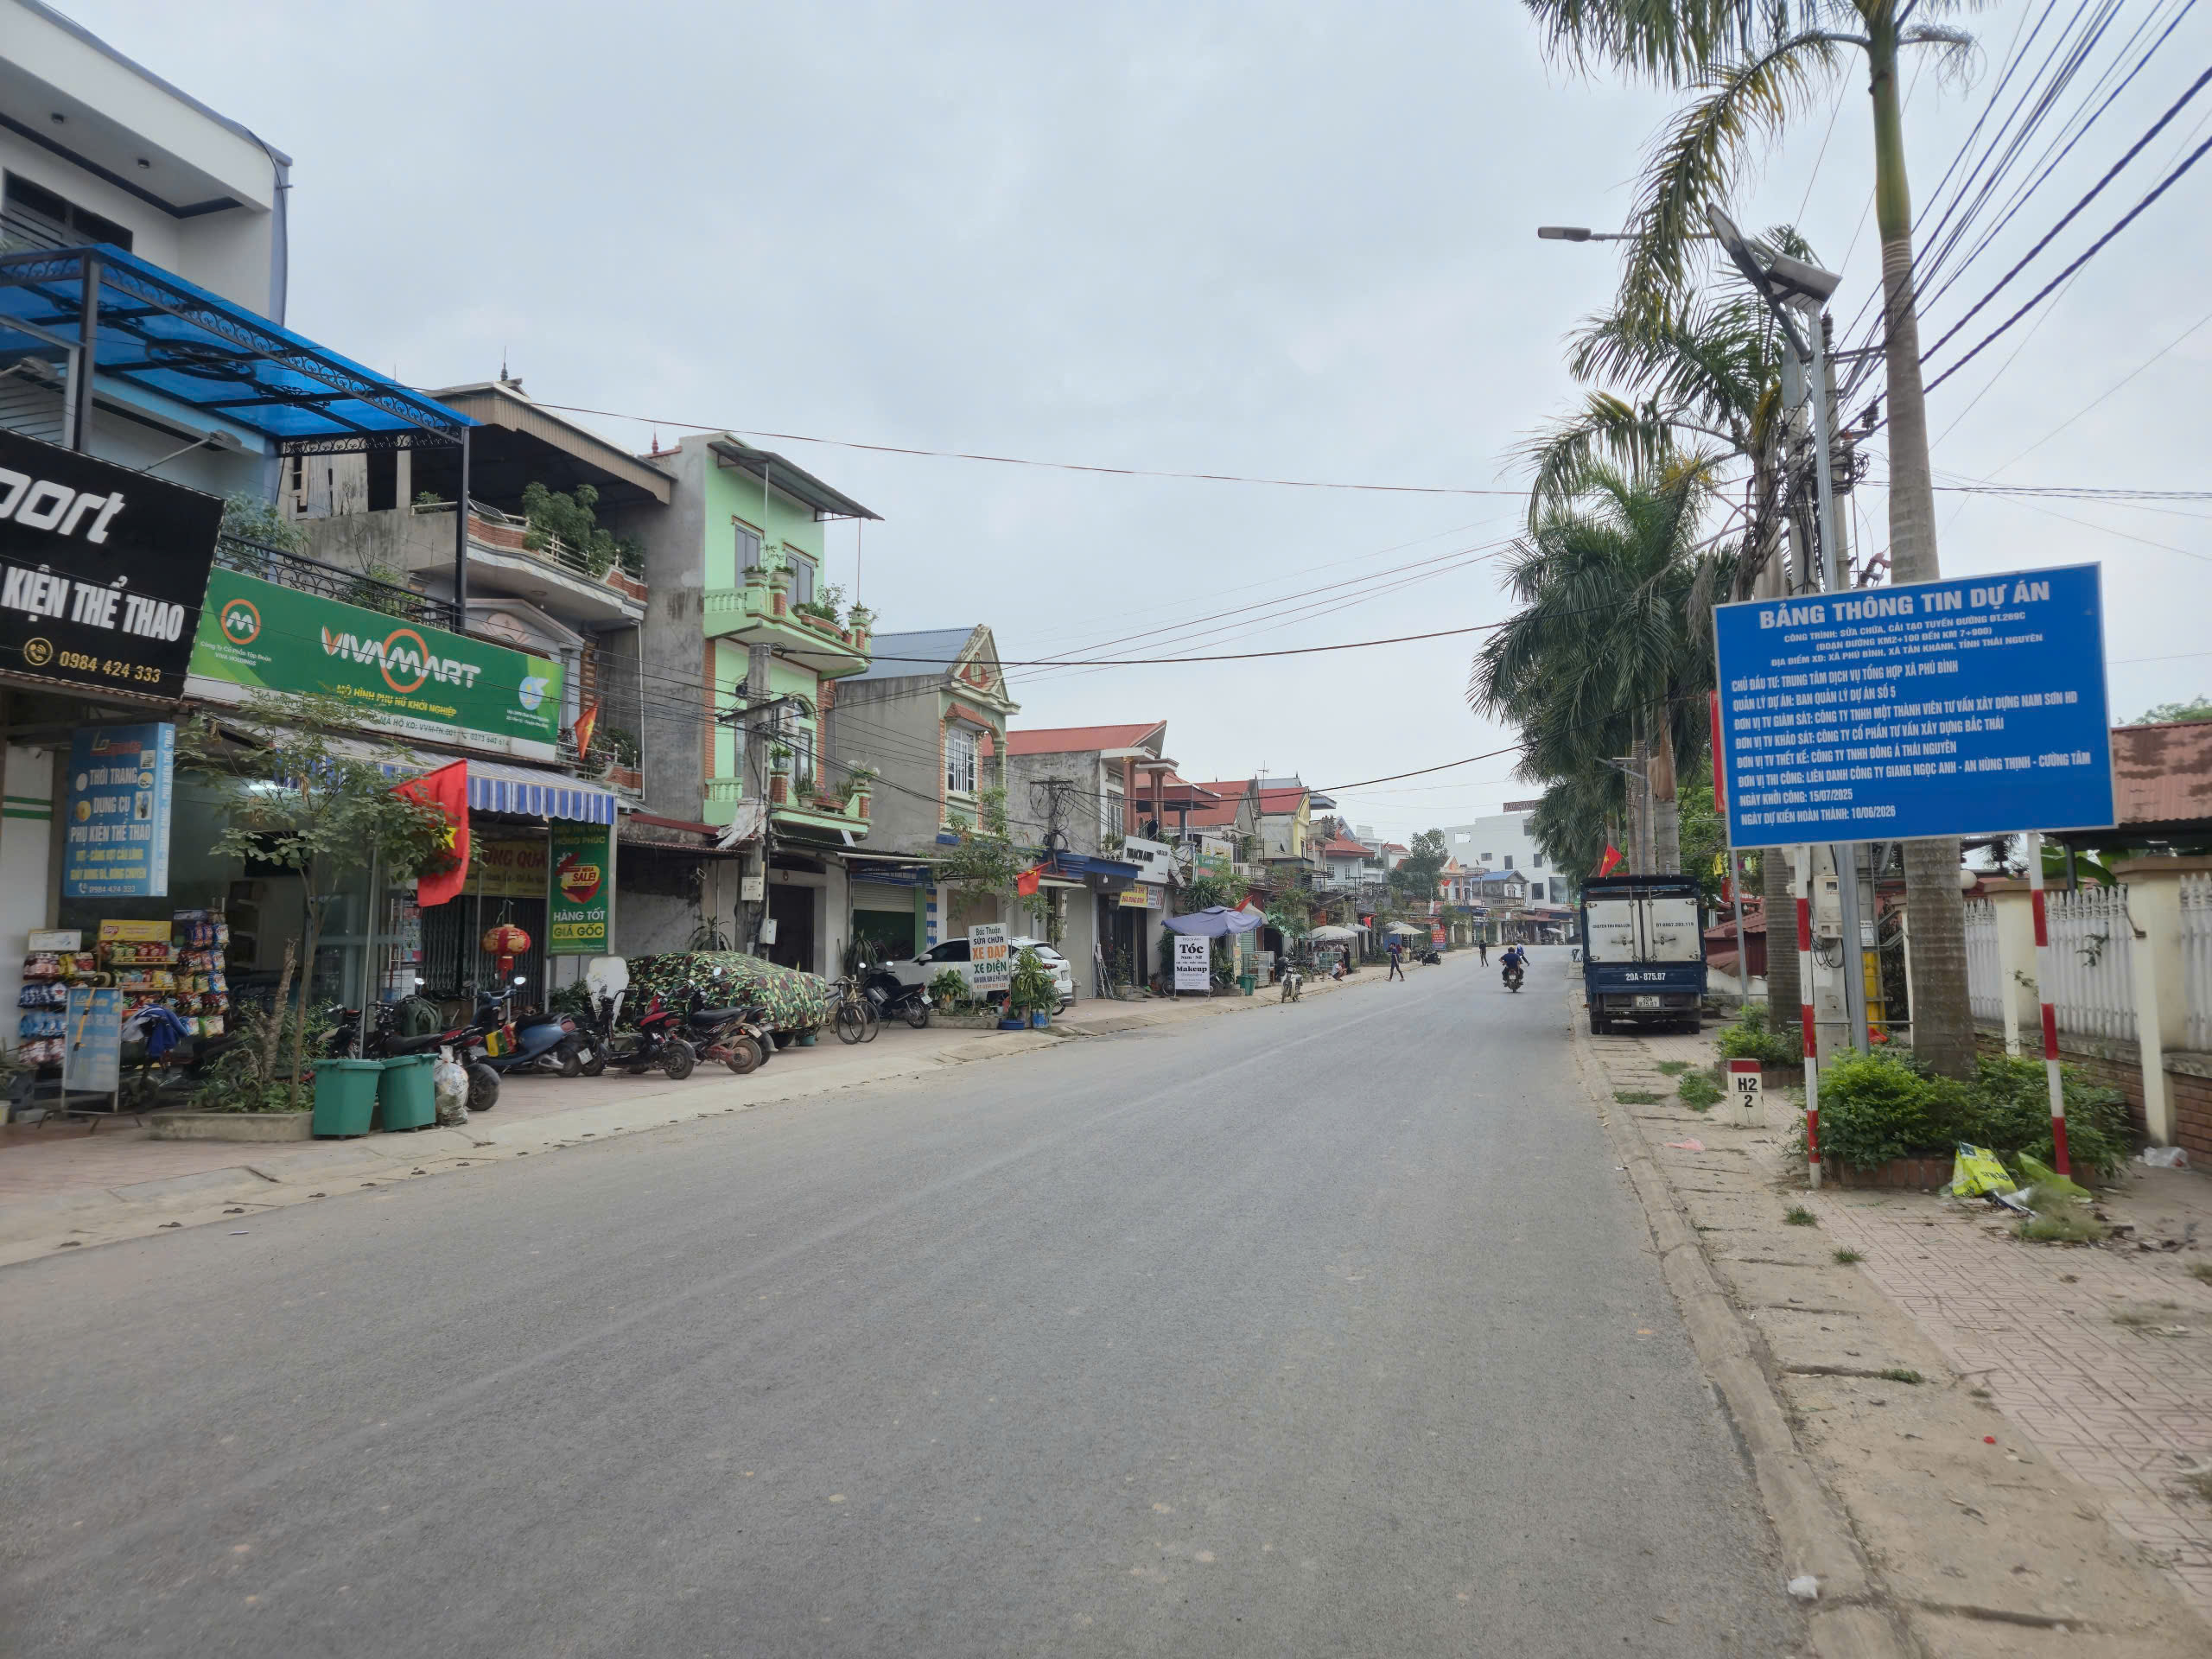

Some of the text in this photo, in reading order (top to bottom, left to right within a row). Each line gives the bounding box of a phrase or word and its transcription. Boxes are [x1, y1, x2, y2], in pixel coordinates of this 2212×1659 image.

[2, 564, 185, 642] KIỆN THỂ THAO
[1759, 580, 2050, 629] BẢNG THÔNG TIN DỰ ÁN
[321, 626, 481, 689] VIVAMART
[60, 651, 162, 683] 0984 424 333
[1731, 659, 1958, 692] CHỦ ĐẦU TƯ: TRUNG TÂM DỊCH VỤ TỔNG HỢP XÃ PHÚ BÌNH
[353, 687, 375, 700] HÌNH
[377, 692, 393, 705] PHỤ
[429, 704, 457, 718] NGHIỆP
[1732, 682, 1896, 712] QUẢN LÝ DỰ ÁN: BAN QUẢN LÝ DỰ ÁN SỐ 5
[111, 767, 137, 785] TRANG
[1738, 788, 1853, 806] NGÀY KHỞI CÔNG: 15/07/2025
[93, 797, 131, 817] DỤNG CỤ
[1741, 804, 1896, 826] NGÀY DỰ KIẾN HOÀN THÀNH: 10/06/2026
[70, 818, 151, 846] PHỤ KIỆN THỂ THAO
[573, 872, 596, 882] SALE!
[553, 907, 606, 922] HÀNG TỐT
[554, 924, 603, 937] GIÁ GỐC
[972, 947, 984, 961] XE
[1179, 943, 1204, 954] Tóc
[974, 960, 1007, 975] XE ĐIỆN
[1625, 972, 1639, 982] 20A
[1643, 972, 1666, 981] 875.87
[1738, 1077, 1758, 1091] H2
[1744, 1095, 1753, 1108] 2
